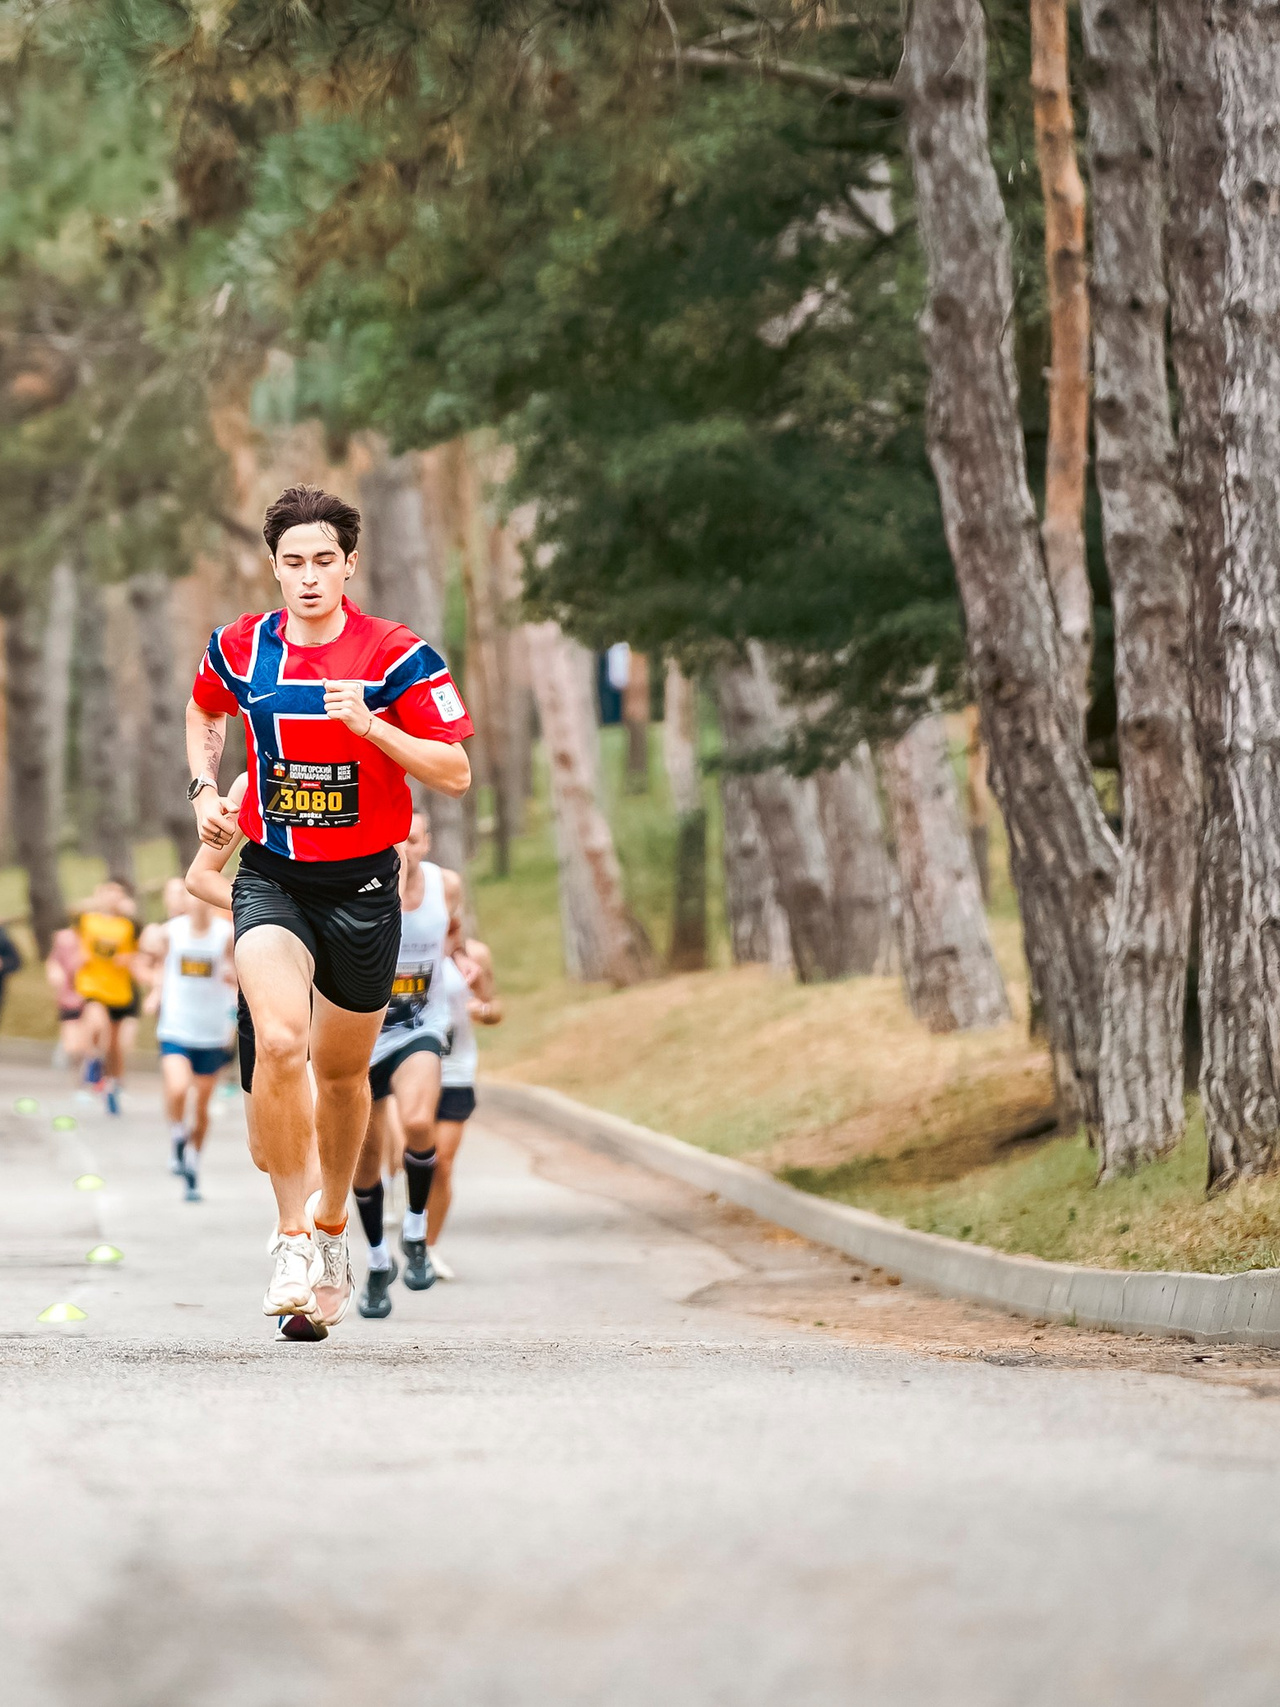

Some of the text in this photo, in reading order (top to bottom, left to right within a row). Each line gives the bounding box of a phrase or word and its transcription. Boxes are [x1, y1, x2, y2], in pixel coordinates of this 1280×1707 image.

[289, 764, 332, 773] ПЯТИГОРСКИЙ
[289, 772, 332, 780] ПОЛУМАРАФОН
[280, 788, 342, 811] 3080
[299, 811, 323, 819] ДВОЙКА
